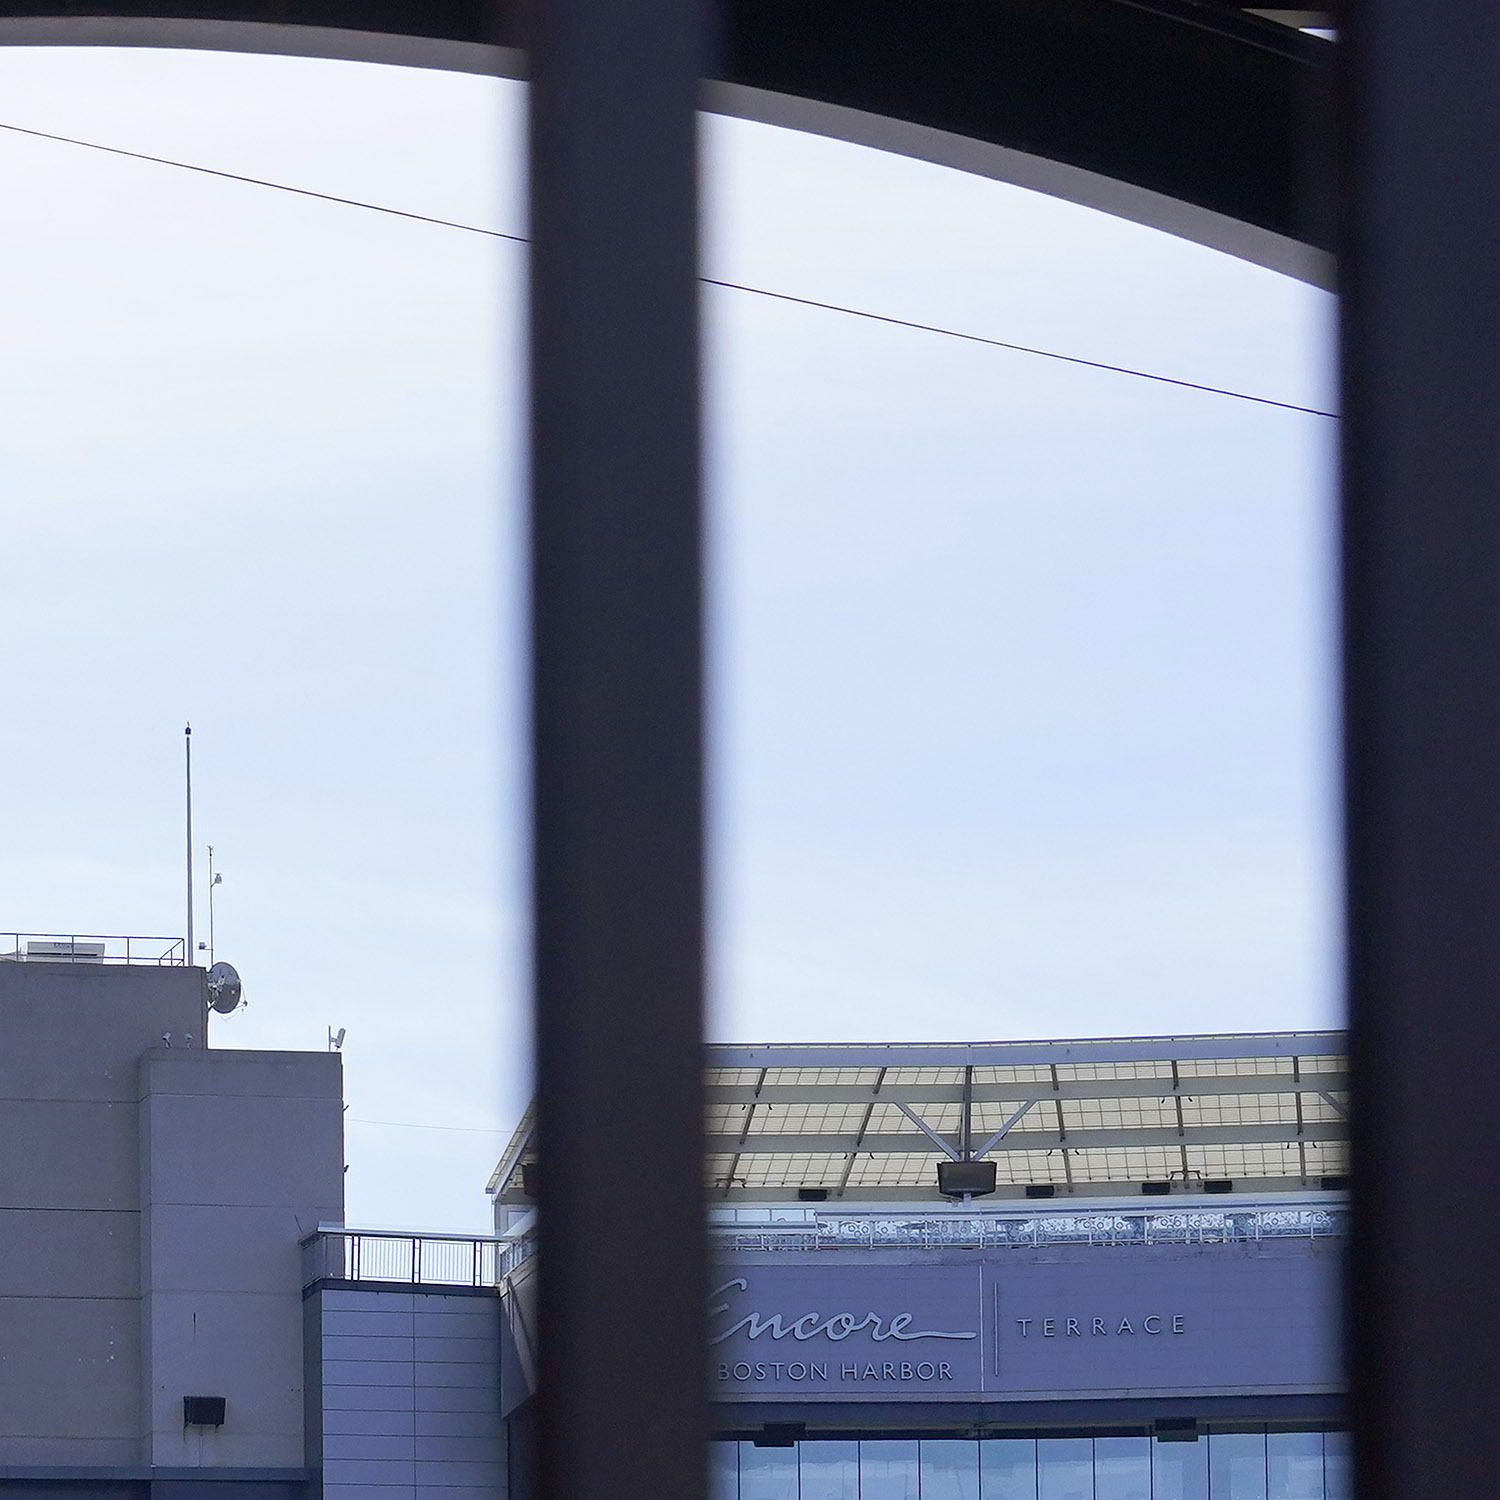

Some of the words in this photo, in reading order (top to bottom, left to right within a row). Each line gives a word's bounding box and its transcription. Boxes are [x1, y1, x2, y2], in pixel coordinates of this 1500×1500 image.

[1015, 1313, 1187, 1338] TERRACE
[718, 1361, 828, 1381] BOSTON
[841, 1361, 953, 1381] HARBOR
